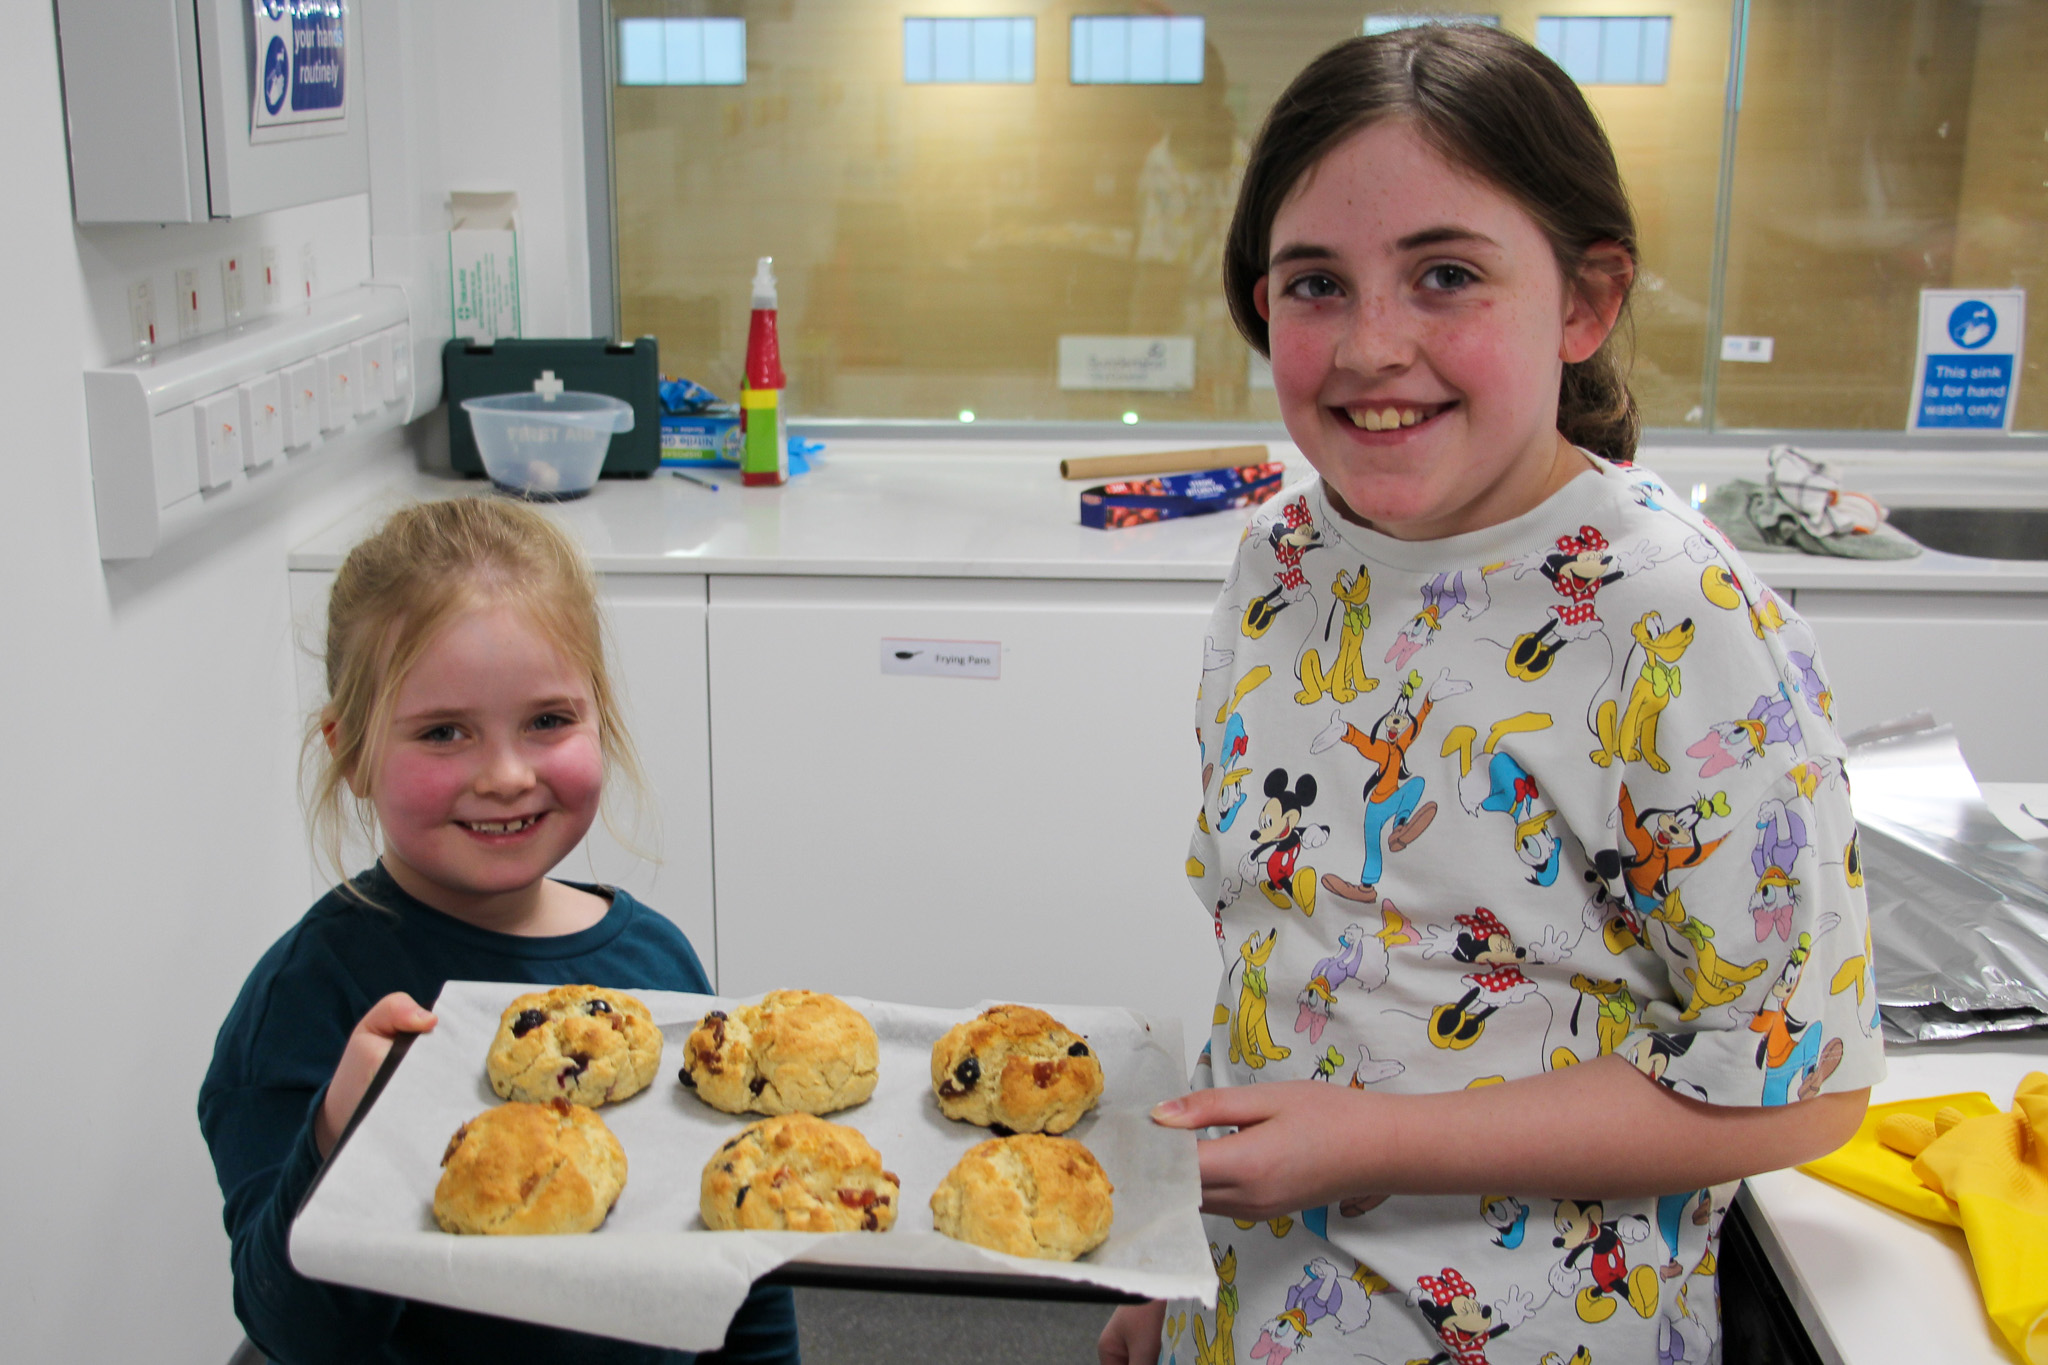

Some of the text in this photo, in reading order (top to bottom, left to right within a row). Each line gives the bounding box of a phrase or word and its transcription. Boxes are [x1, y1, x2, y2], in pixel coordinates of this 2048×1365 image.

[294, 23, 343, 55] your hands
[299, 58, 339, 89] routinely
[1936, 365, 2001, 379] This sink
[1925, 383, 2007, 398] is for hand
[1924, 404, 2000, 418] wash only
[679, 436, 715, 447] Nitrile
[935, 654, 991, 666] Frying Pans
